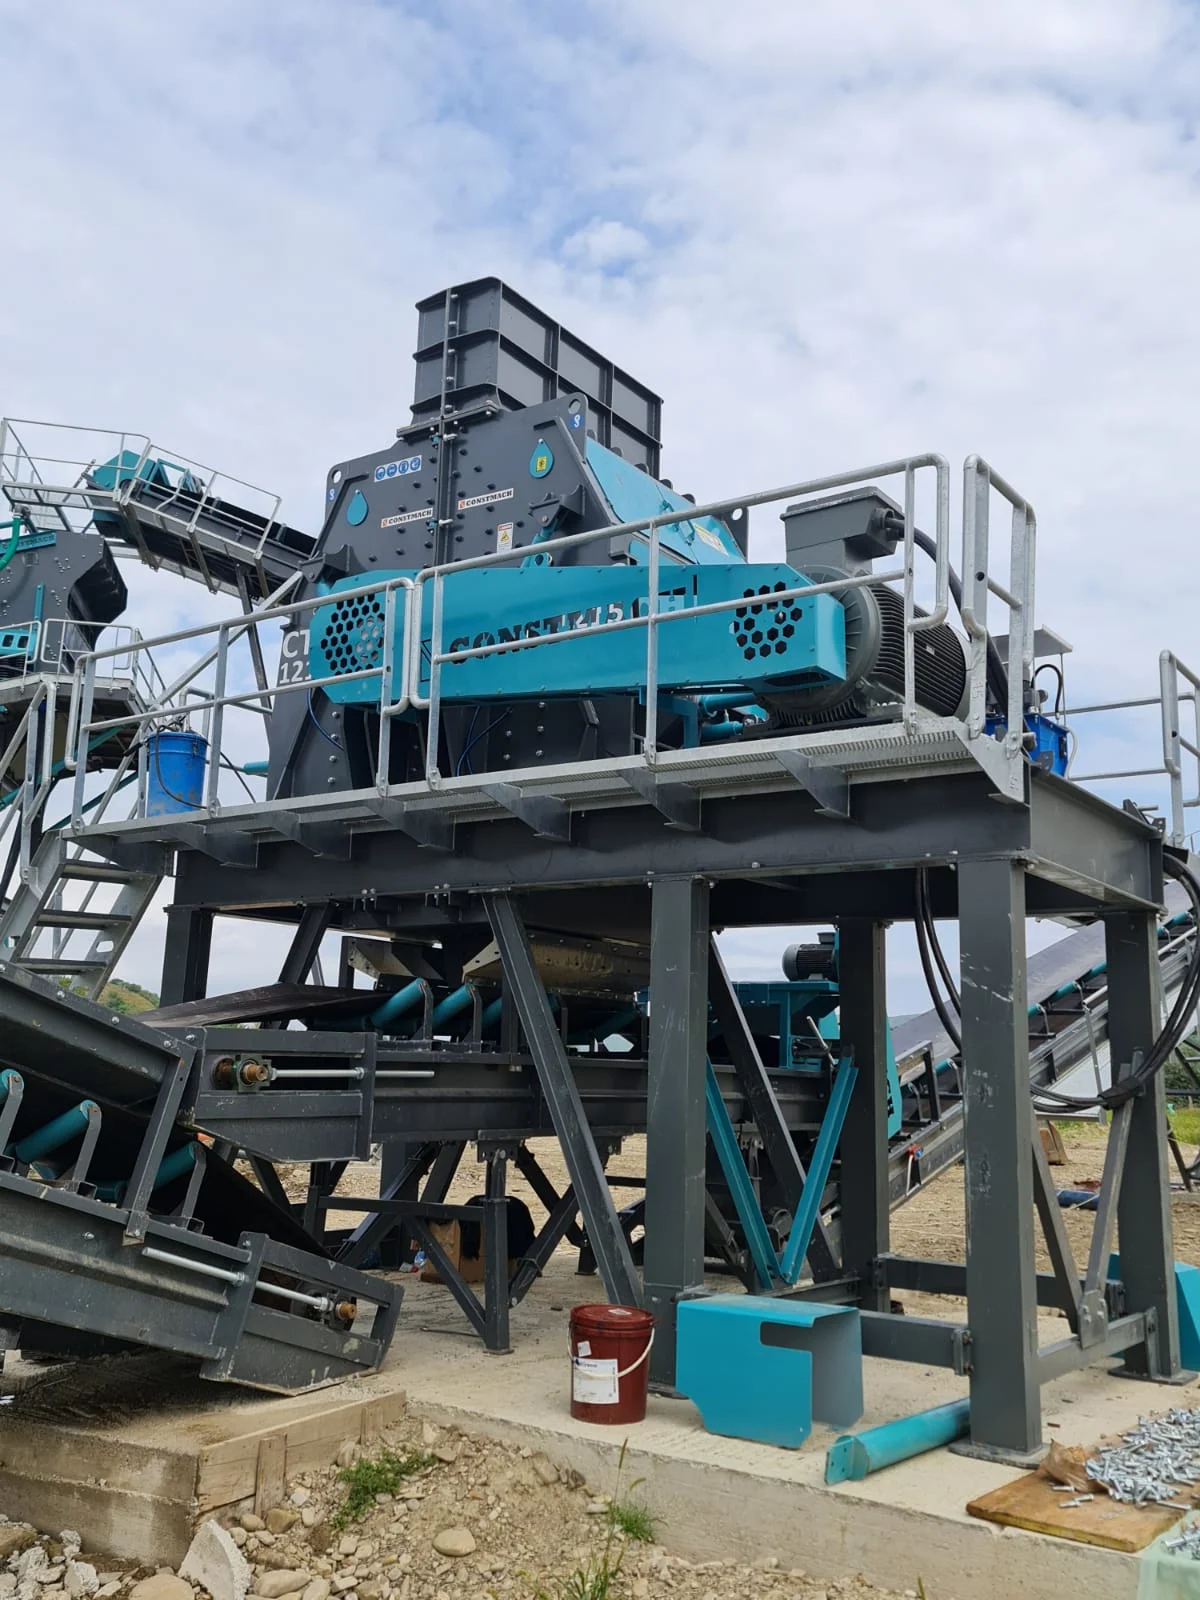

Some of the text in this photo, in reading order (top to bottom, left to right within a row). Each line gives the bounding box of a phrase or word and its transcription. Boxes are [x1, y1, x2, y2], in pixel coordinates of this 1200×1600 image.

[466, 490, 513, 507] CONSTMACH
[388, 509, 432, 525] CONSTMACH
[279, 660, 312, 684] 12
